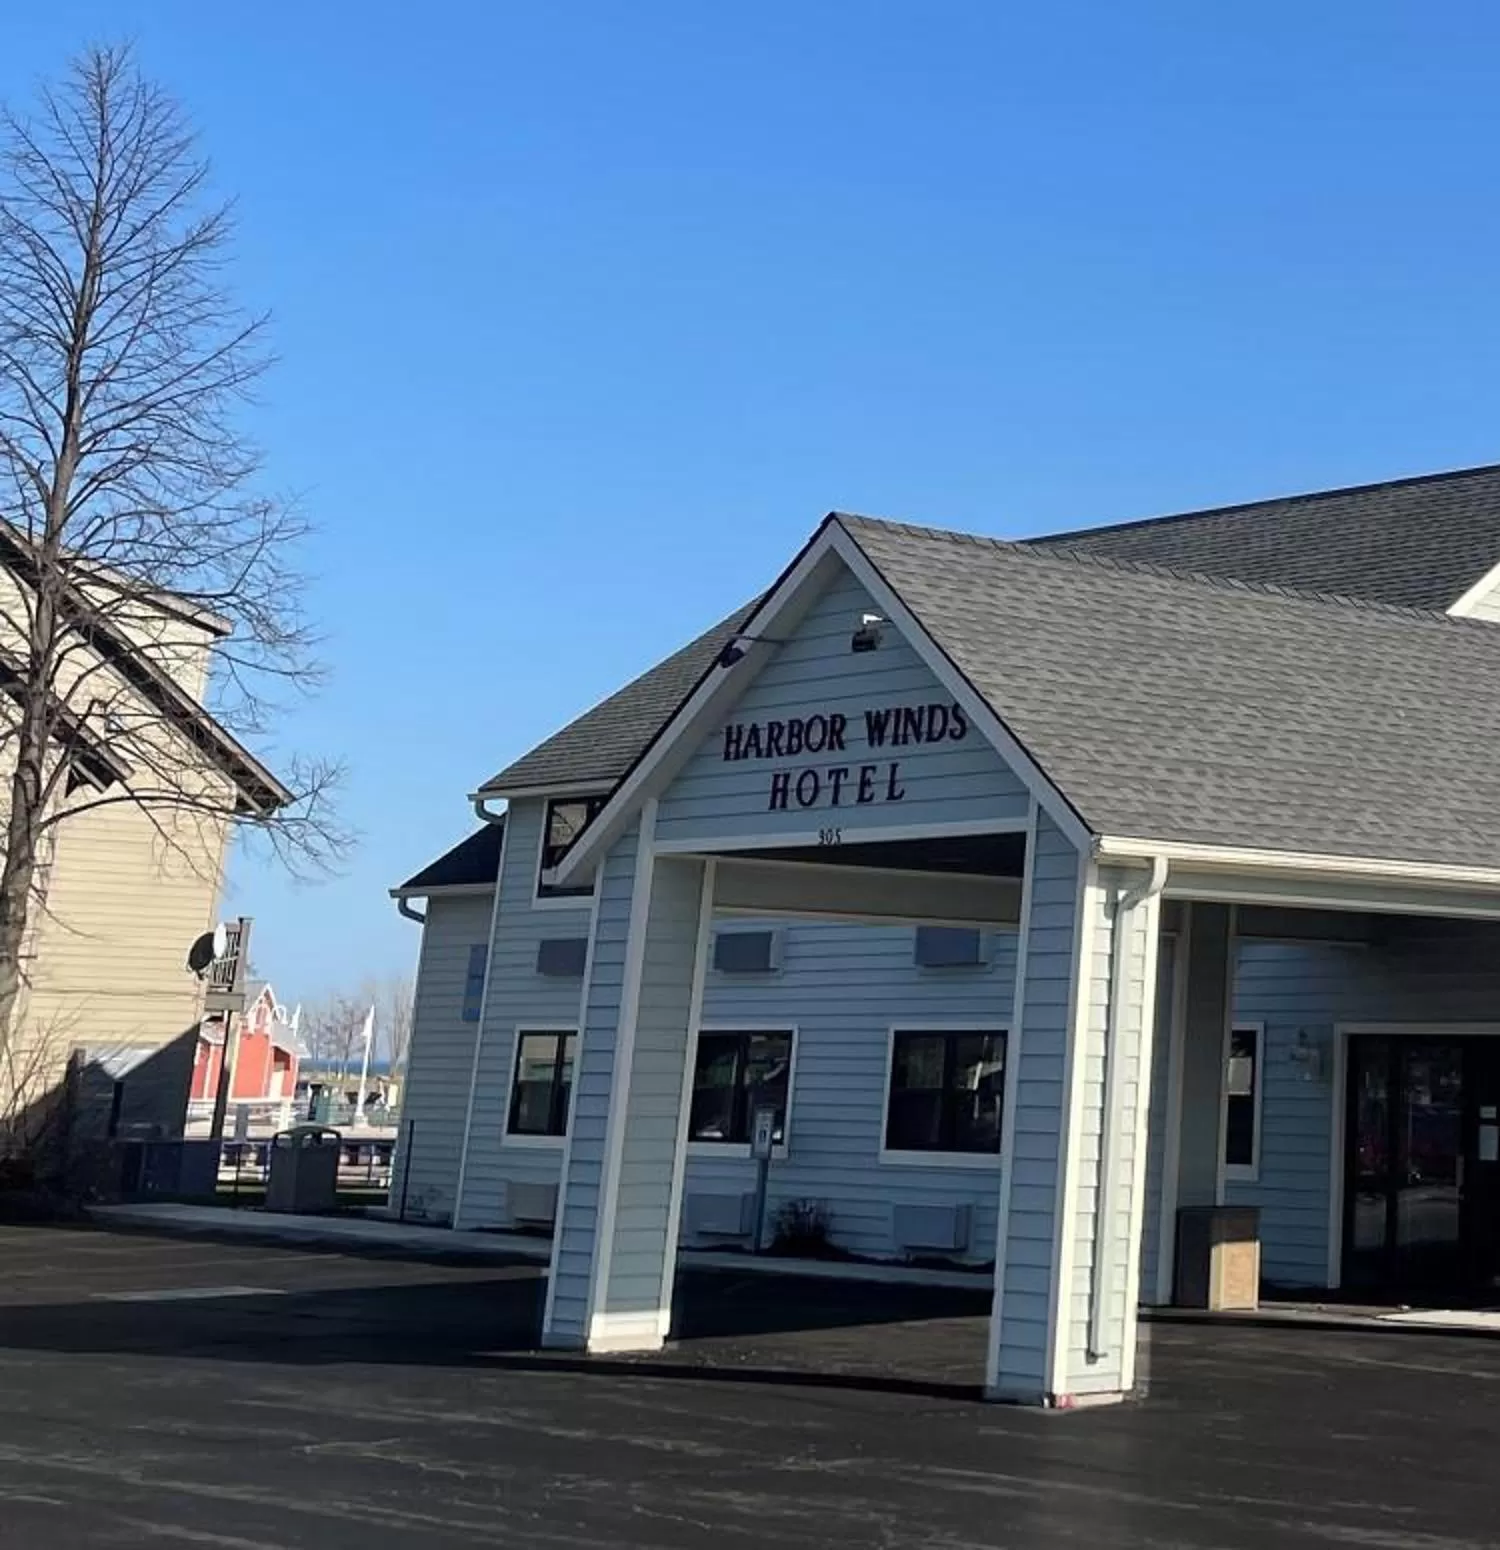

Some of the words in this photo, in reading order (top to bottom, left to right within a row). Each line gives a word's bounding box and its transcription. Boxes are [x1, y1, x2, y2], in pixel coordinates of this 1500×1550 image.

[723, 714, 846, 761] HARBOR
[865, 703, 967, 747] WINDS
[768, 763, 905, 810] HOTEL
